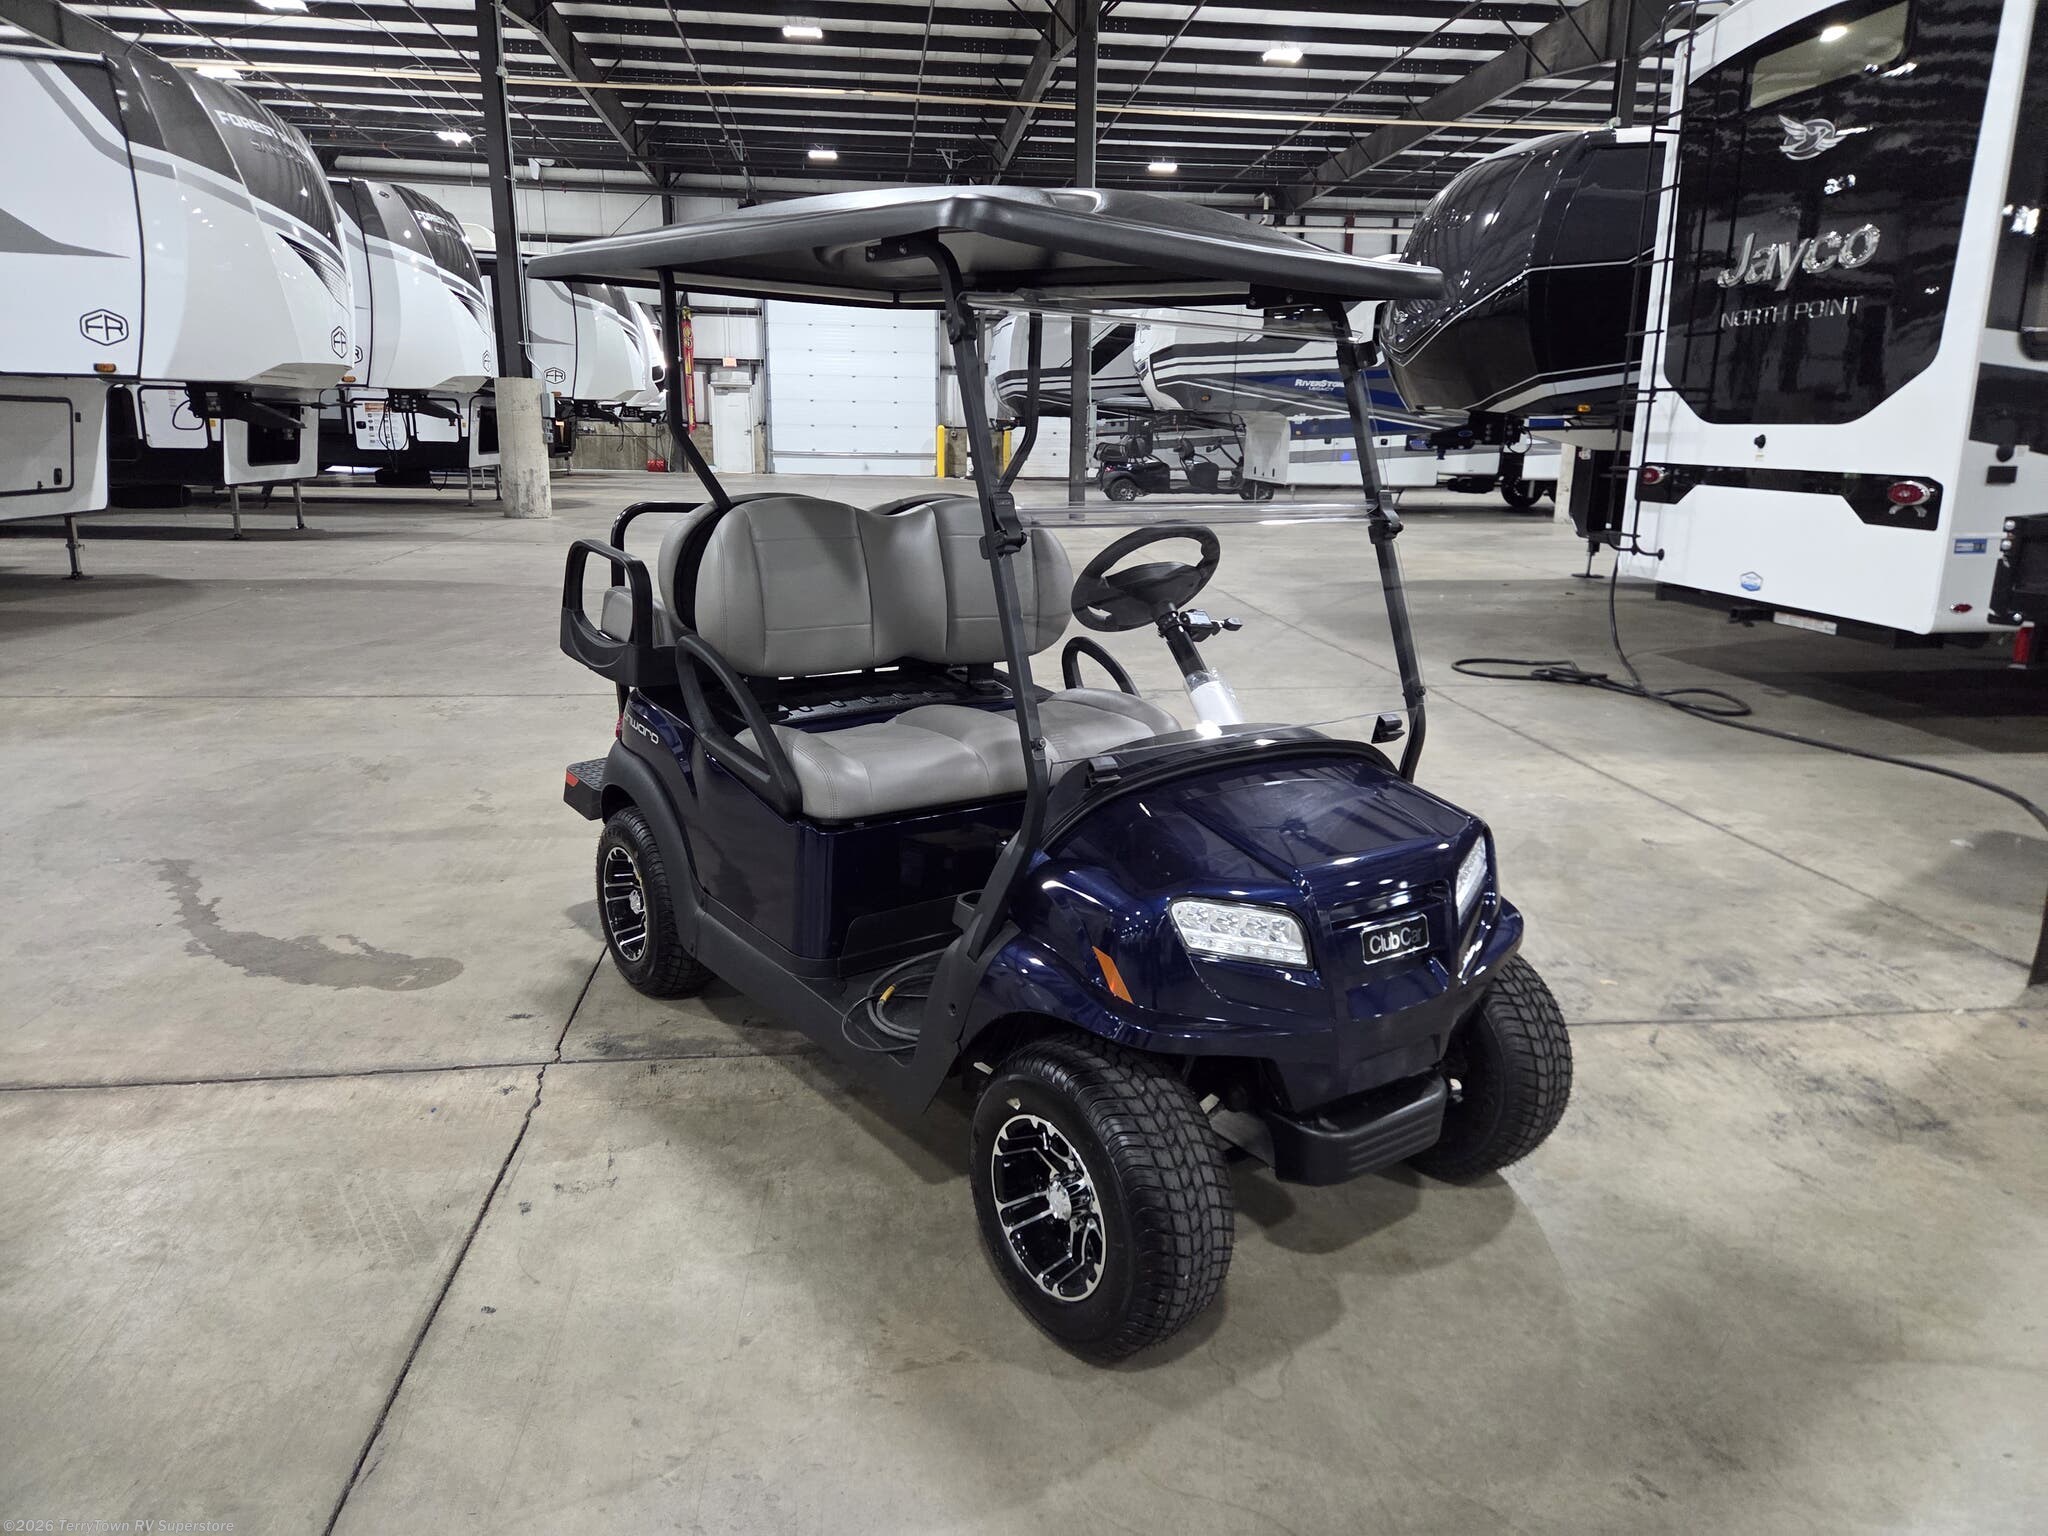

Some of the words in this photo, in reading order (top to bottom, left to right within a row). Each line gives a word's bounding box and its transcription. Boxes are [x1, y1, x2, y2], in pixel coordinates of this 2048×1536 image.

[214, 109, 279, 140] FOREST
[1717, 223, 1881, 292] Jayco
[1720, 304, 1789, 329] NORTH
[1794, 295, 1865, 321] POINT
